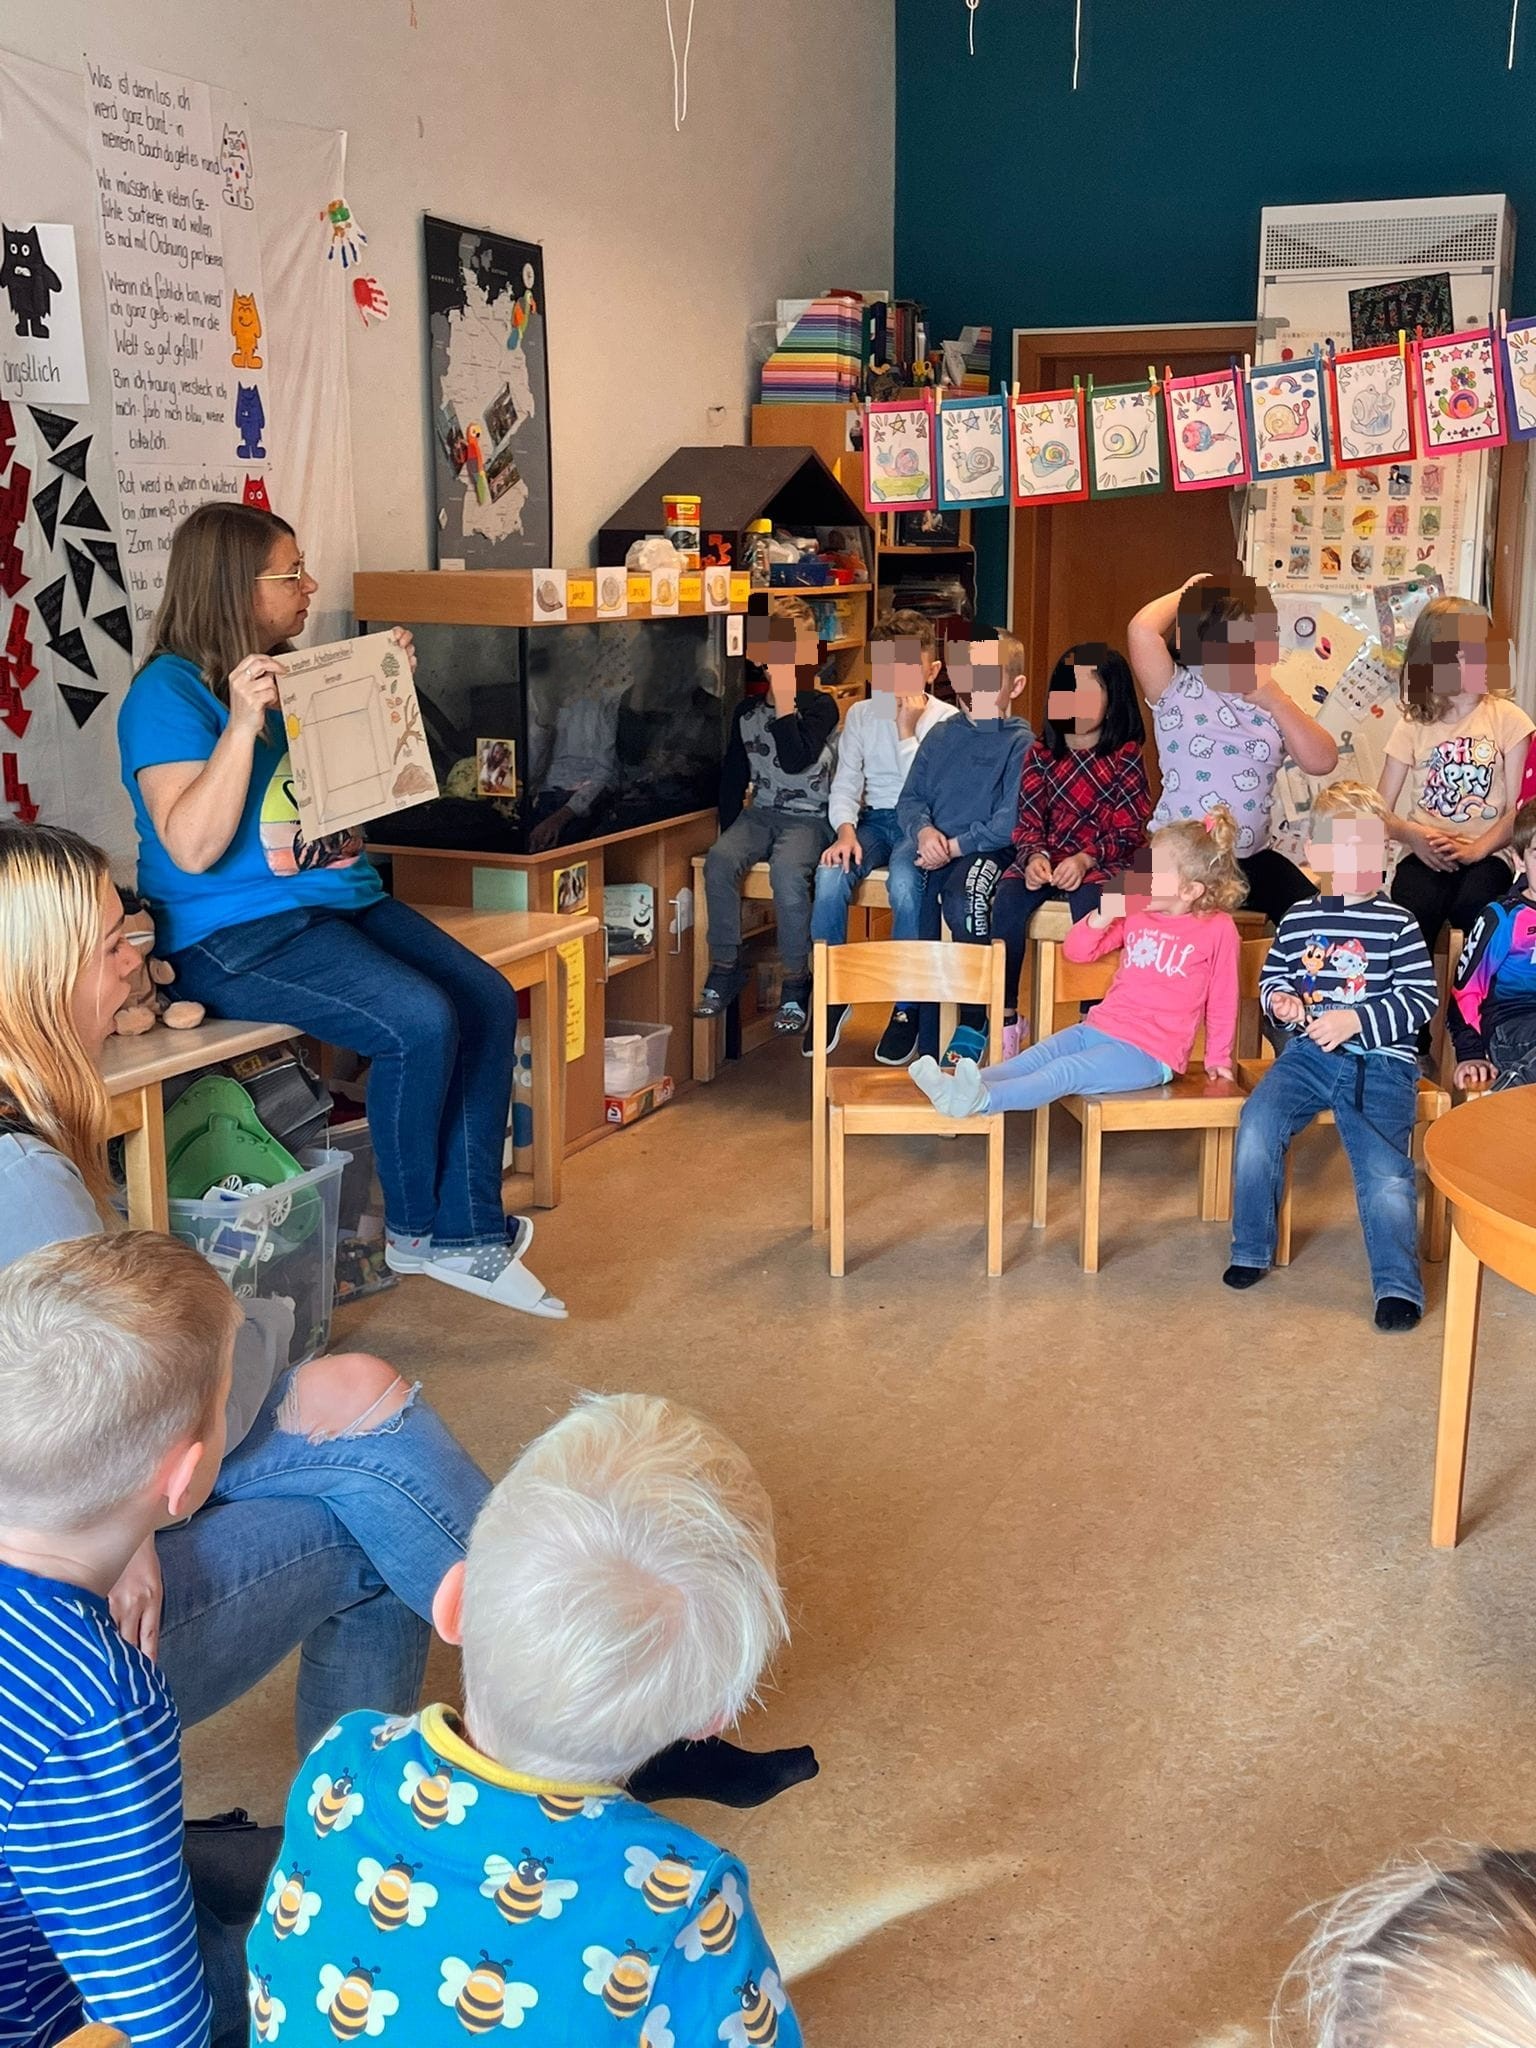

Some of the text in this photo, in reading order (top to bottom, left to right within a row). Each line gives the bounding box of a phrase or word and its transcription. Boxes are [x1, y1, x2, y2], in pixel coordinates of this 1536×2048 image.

[87, 62, 112, 90] Was
[150, 230, 188, 269] Ordnung
[106, 270, 138, 296] Wenn
[114, 329, 138, 356] Welt
[112, 368, 130, 389] Bin
[117, 469, 136, 495] Rot
[126, 528, 153, 554] Zorn
[974, 893, 989, 937] ROUGH
